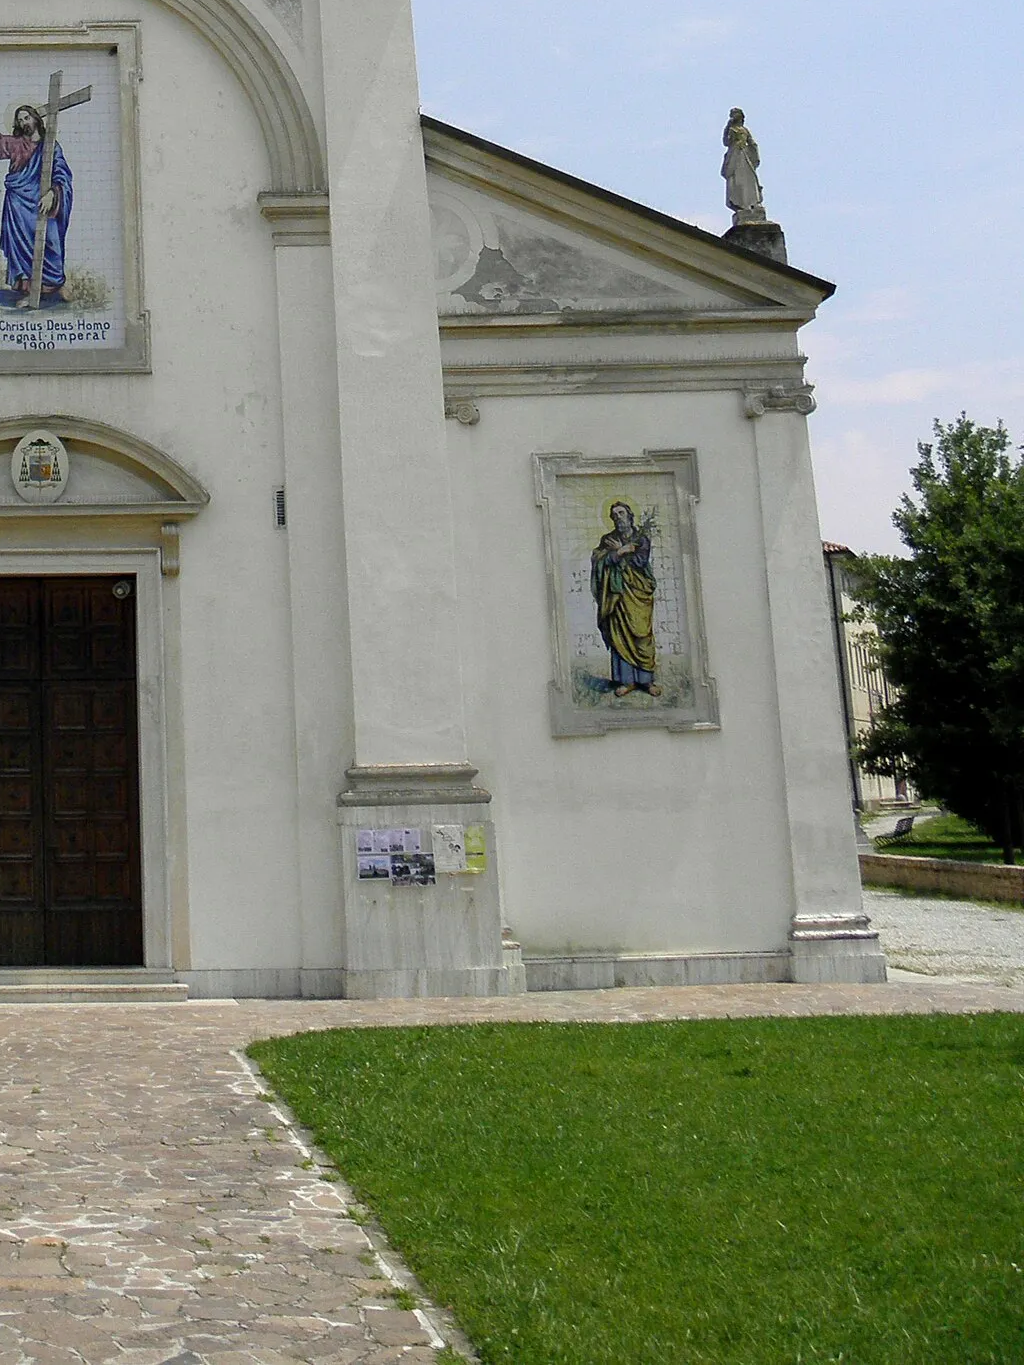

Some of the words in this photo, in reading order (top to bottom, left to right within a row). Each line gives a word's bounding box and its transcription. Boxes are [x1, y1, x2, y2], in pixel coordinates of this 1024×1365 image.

[47, 319, 74, 331] Deus
[77, 319, 111, 331] Homo
[3, 331, 43, 344] regnat
[51, 330, 106, 344] imperat
[23, 341, 55, 350] 1900
